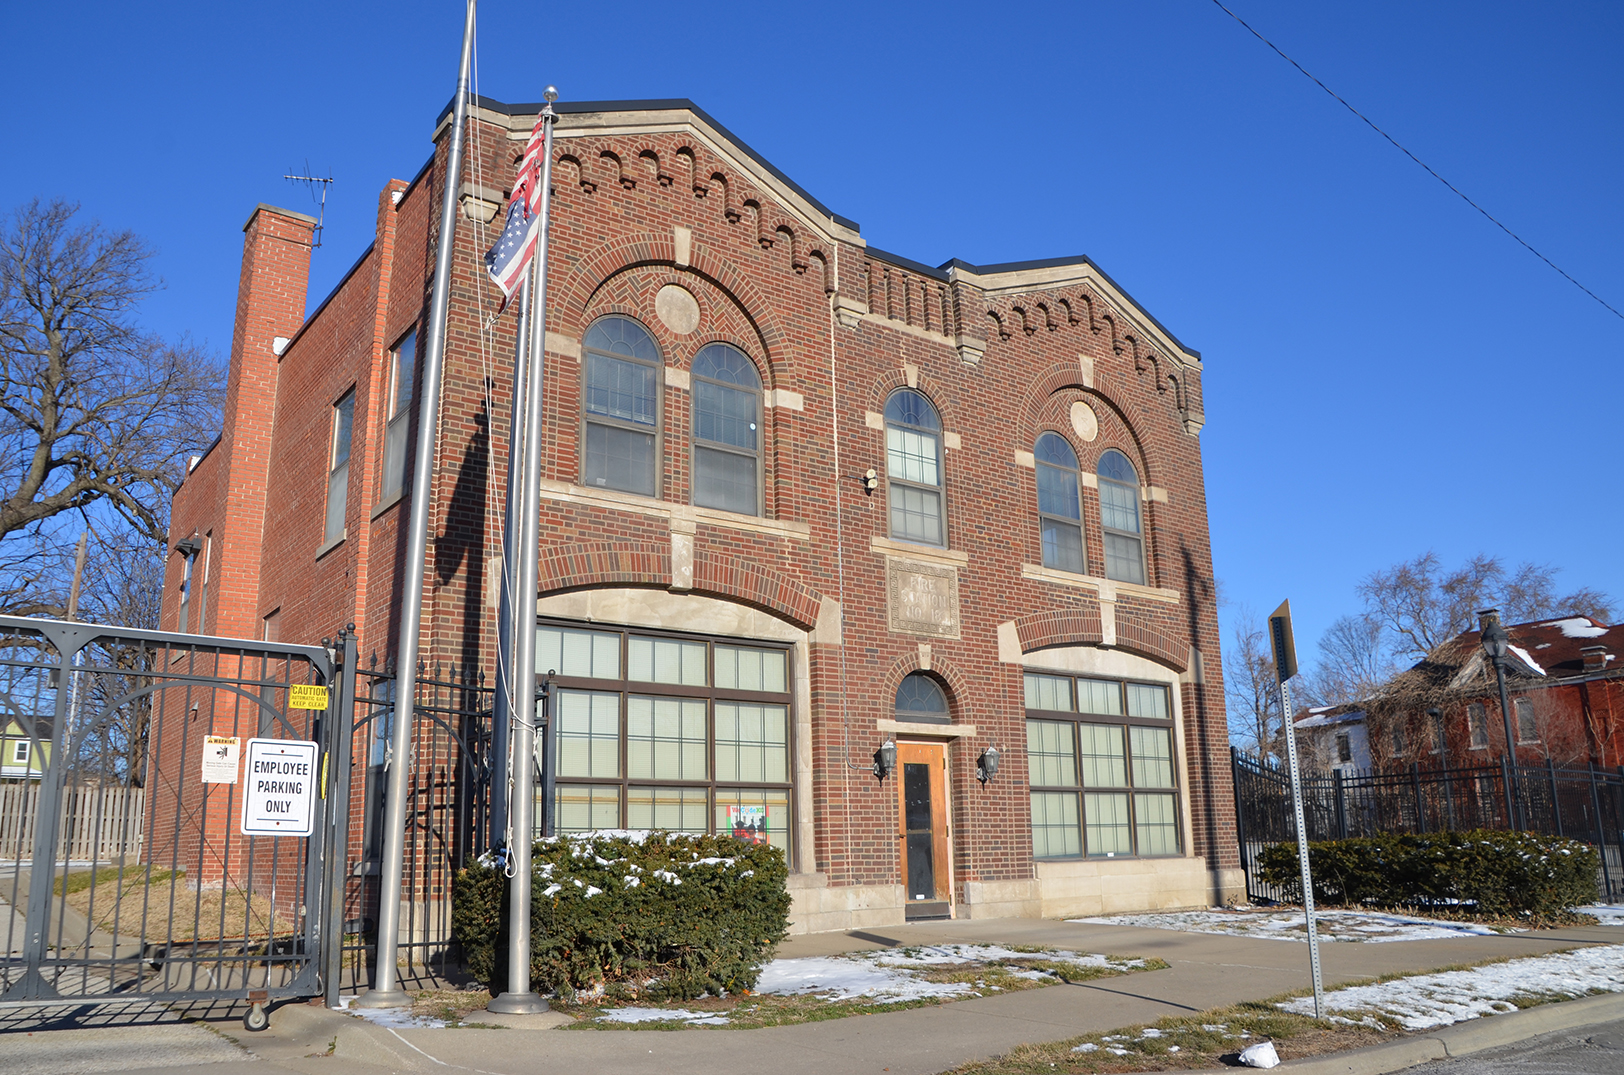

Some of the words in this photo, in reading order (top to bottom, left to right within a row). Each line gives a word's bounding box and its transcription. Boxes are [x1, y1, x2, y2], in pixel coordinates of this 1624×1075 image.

[910, 576, 936, 592] FIRE
[900, 588, 947, 608] STATION
[931, 608, 943, 623] 18
[292, 686, 327, 696] CAUTION
[254, 760, 309, 776] EMPLOYEE
[257, 780, 303, 795] PARKING
[265, 799, 292, 813] ONLY
